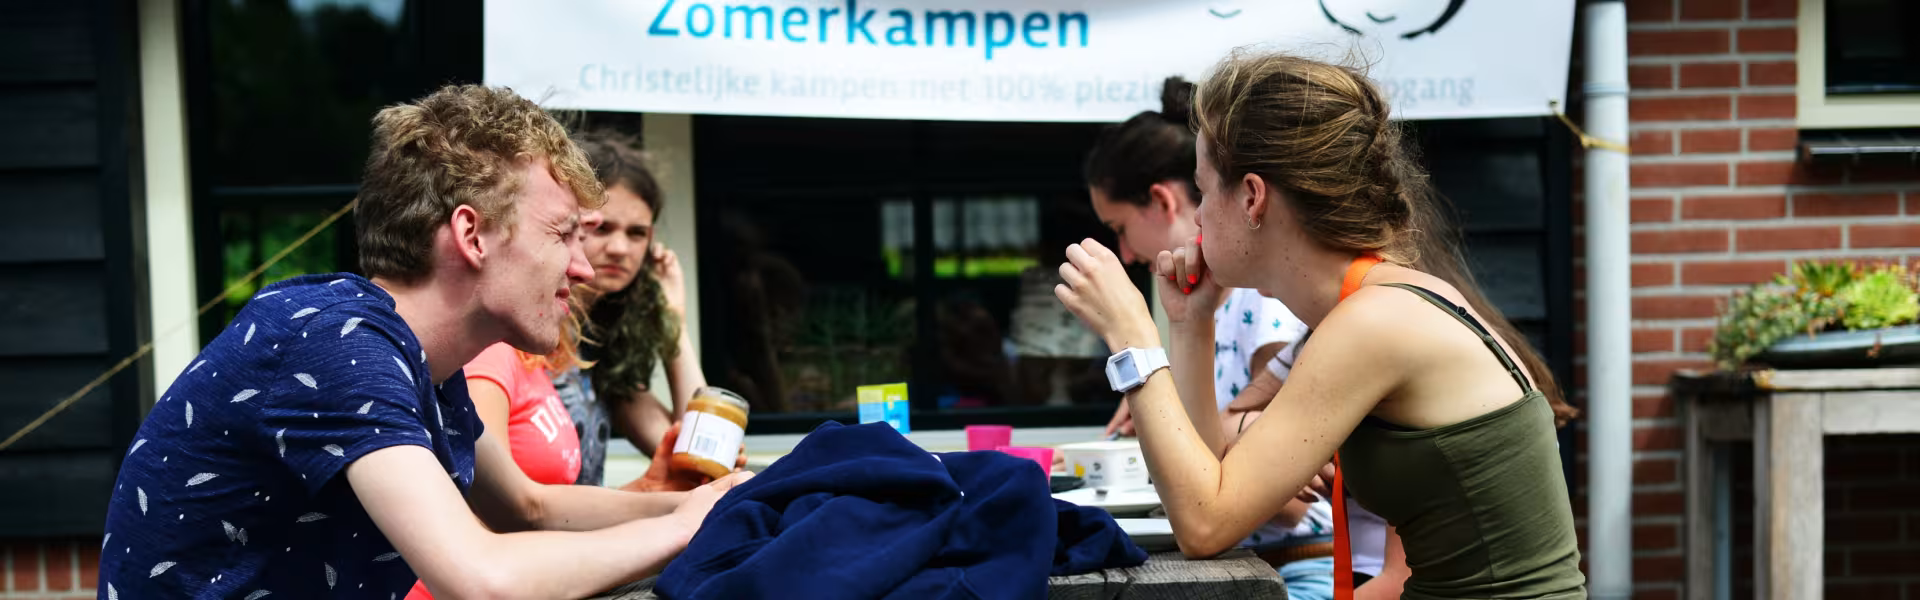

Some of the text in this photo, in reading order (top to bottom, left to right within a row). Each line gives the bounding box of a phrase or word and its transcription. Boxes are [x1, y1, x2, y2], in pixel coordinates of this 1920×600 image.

[647, 0, 1089, 60] Zomerkampen
[578, 62, 761, 101] Christelijke
[769, 67, 899, 106] kampen
[908, 76, 971, 103] met
[982, 73, 1066, 102] 100%
[1075, 73, 1157, 110] plezi
